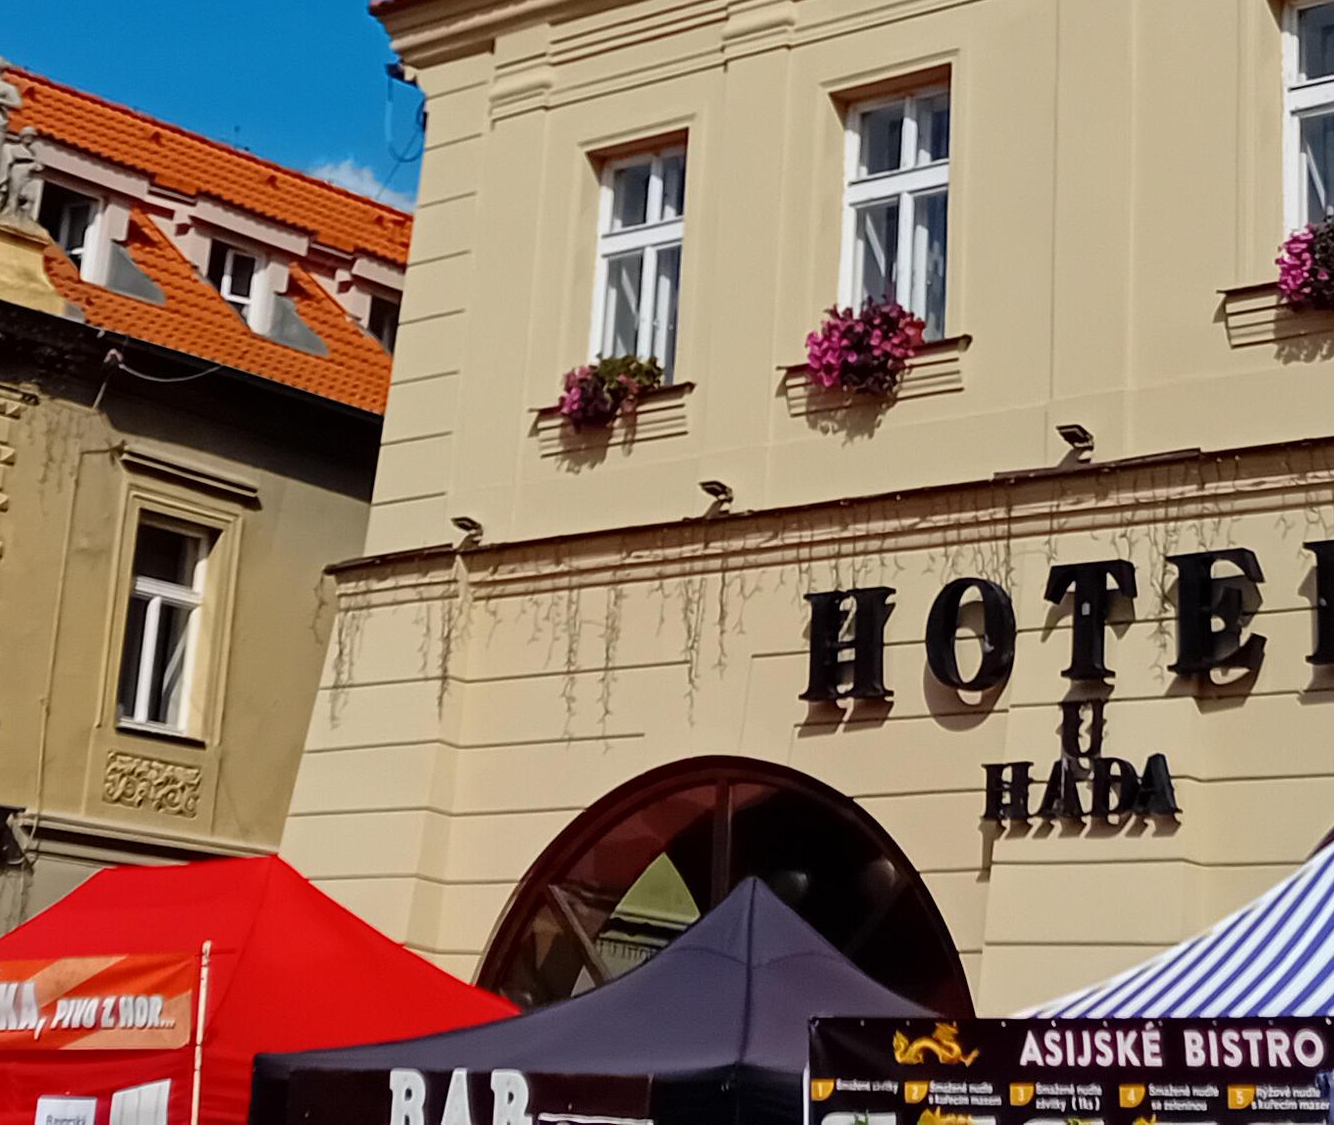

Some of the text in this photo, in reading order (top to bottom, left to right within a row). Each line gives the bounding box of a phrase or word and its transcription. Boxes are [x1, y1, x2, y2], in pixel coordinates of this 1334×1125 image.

[1057, 696, 1107, 758] U
[983, 753, 1183, 825] HADA
[51, 998, 98, 1030] PIVO
[99, 996, 117, 1029] Z
[1019, 1021, 1325, 1068] ASIJSKÉ BISTRO
[389, 1068, 533, 1125] BAR
